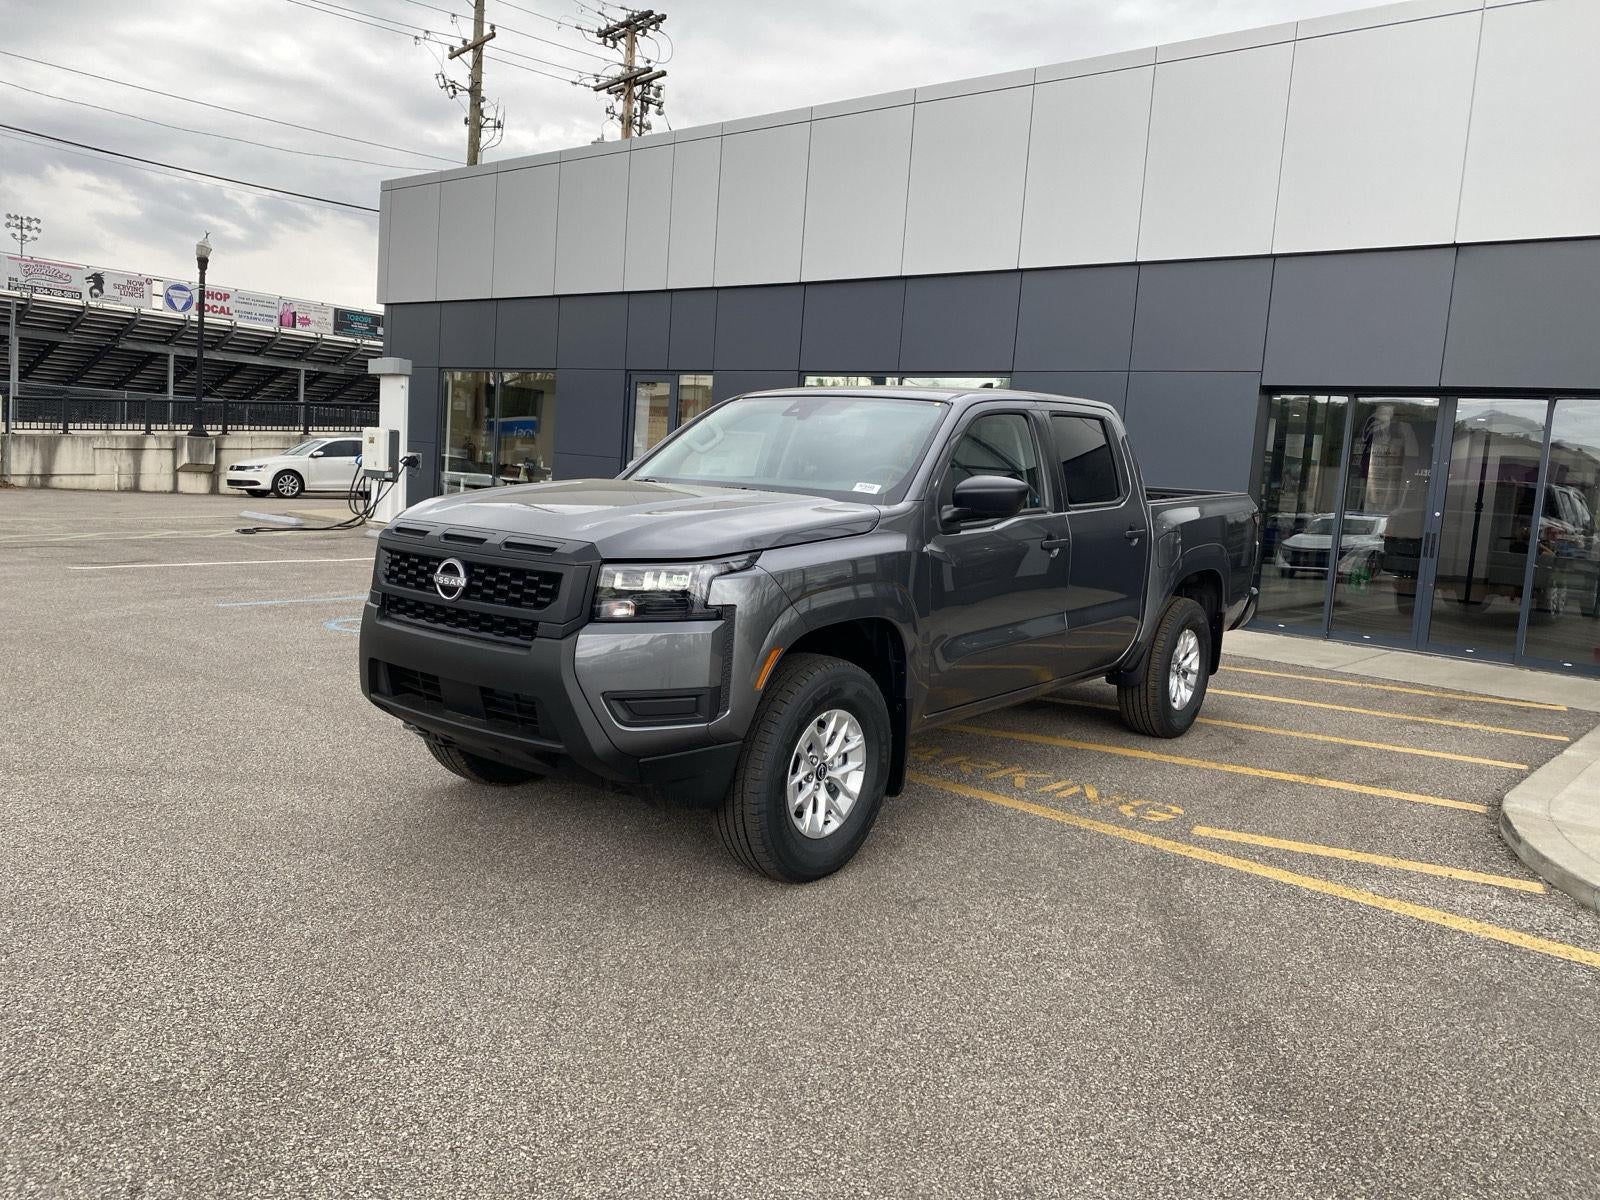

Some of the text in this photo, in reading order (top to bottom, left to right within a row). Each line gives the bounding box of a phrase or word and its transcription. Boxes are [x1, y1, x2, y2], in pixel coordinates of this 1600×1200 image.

[113, 283, 144, 293] SERVING
[126, 279, 145, 287] NOW
[120, 290, 144, 299] LUNCH
[433, 574, 466, 587] NISSAN
[908, 744, 1185, 823] ARKING
